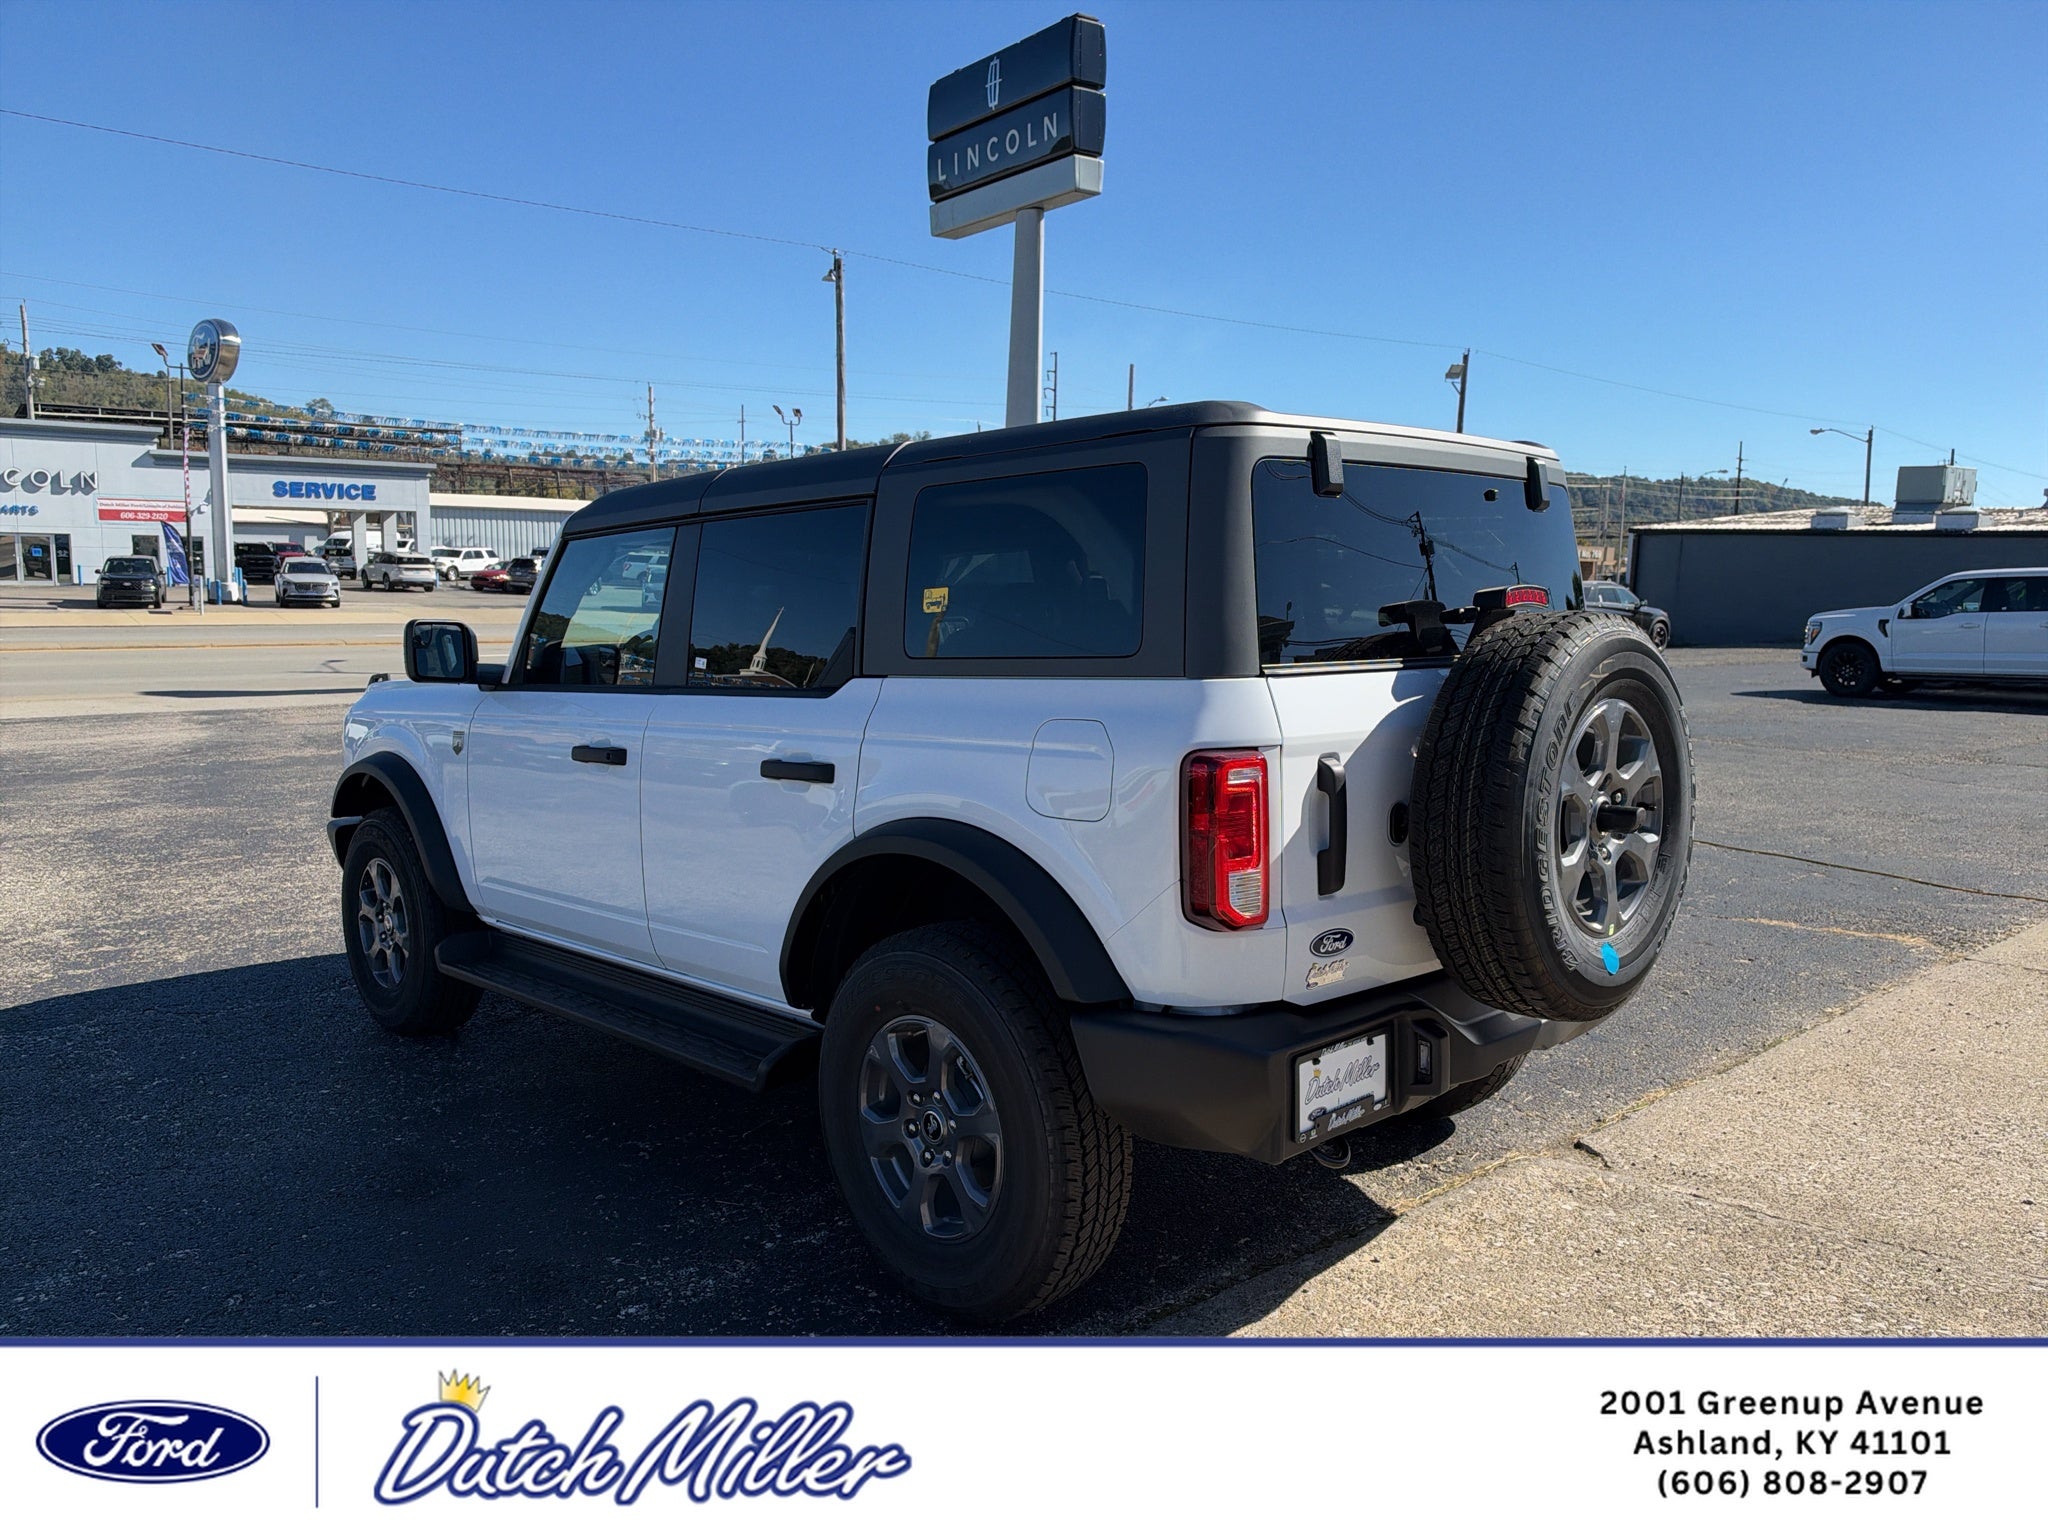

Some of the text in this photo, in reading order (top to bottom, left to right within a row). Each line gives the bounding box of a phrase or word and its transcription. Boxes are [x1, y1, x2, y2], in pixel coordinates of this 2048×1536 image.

[937, 112, 1058, 182] LINCOLN
[272, 480, 377, 501] SERVICE
[120, 511, 169, 520] 606-329-2120
[1320, 934, 1348, 953] Ford
[1305, 1068, 1341, 1105] Dutch
[1339, 1055, 1380, 1092] Miller
